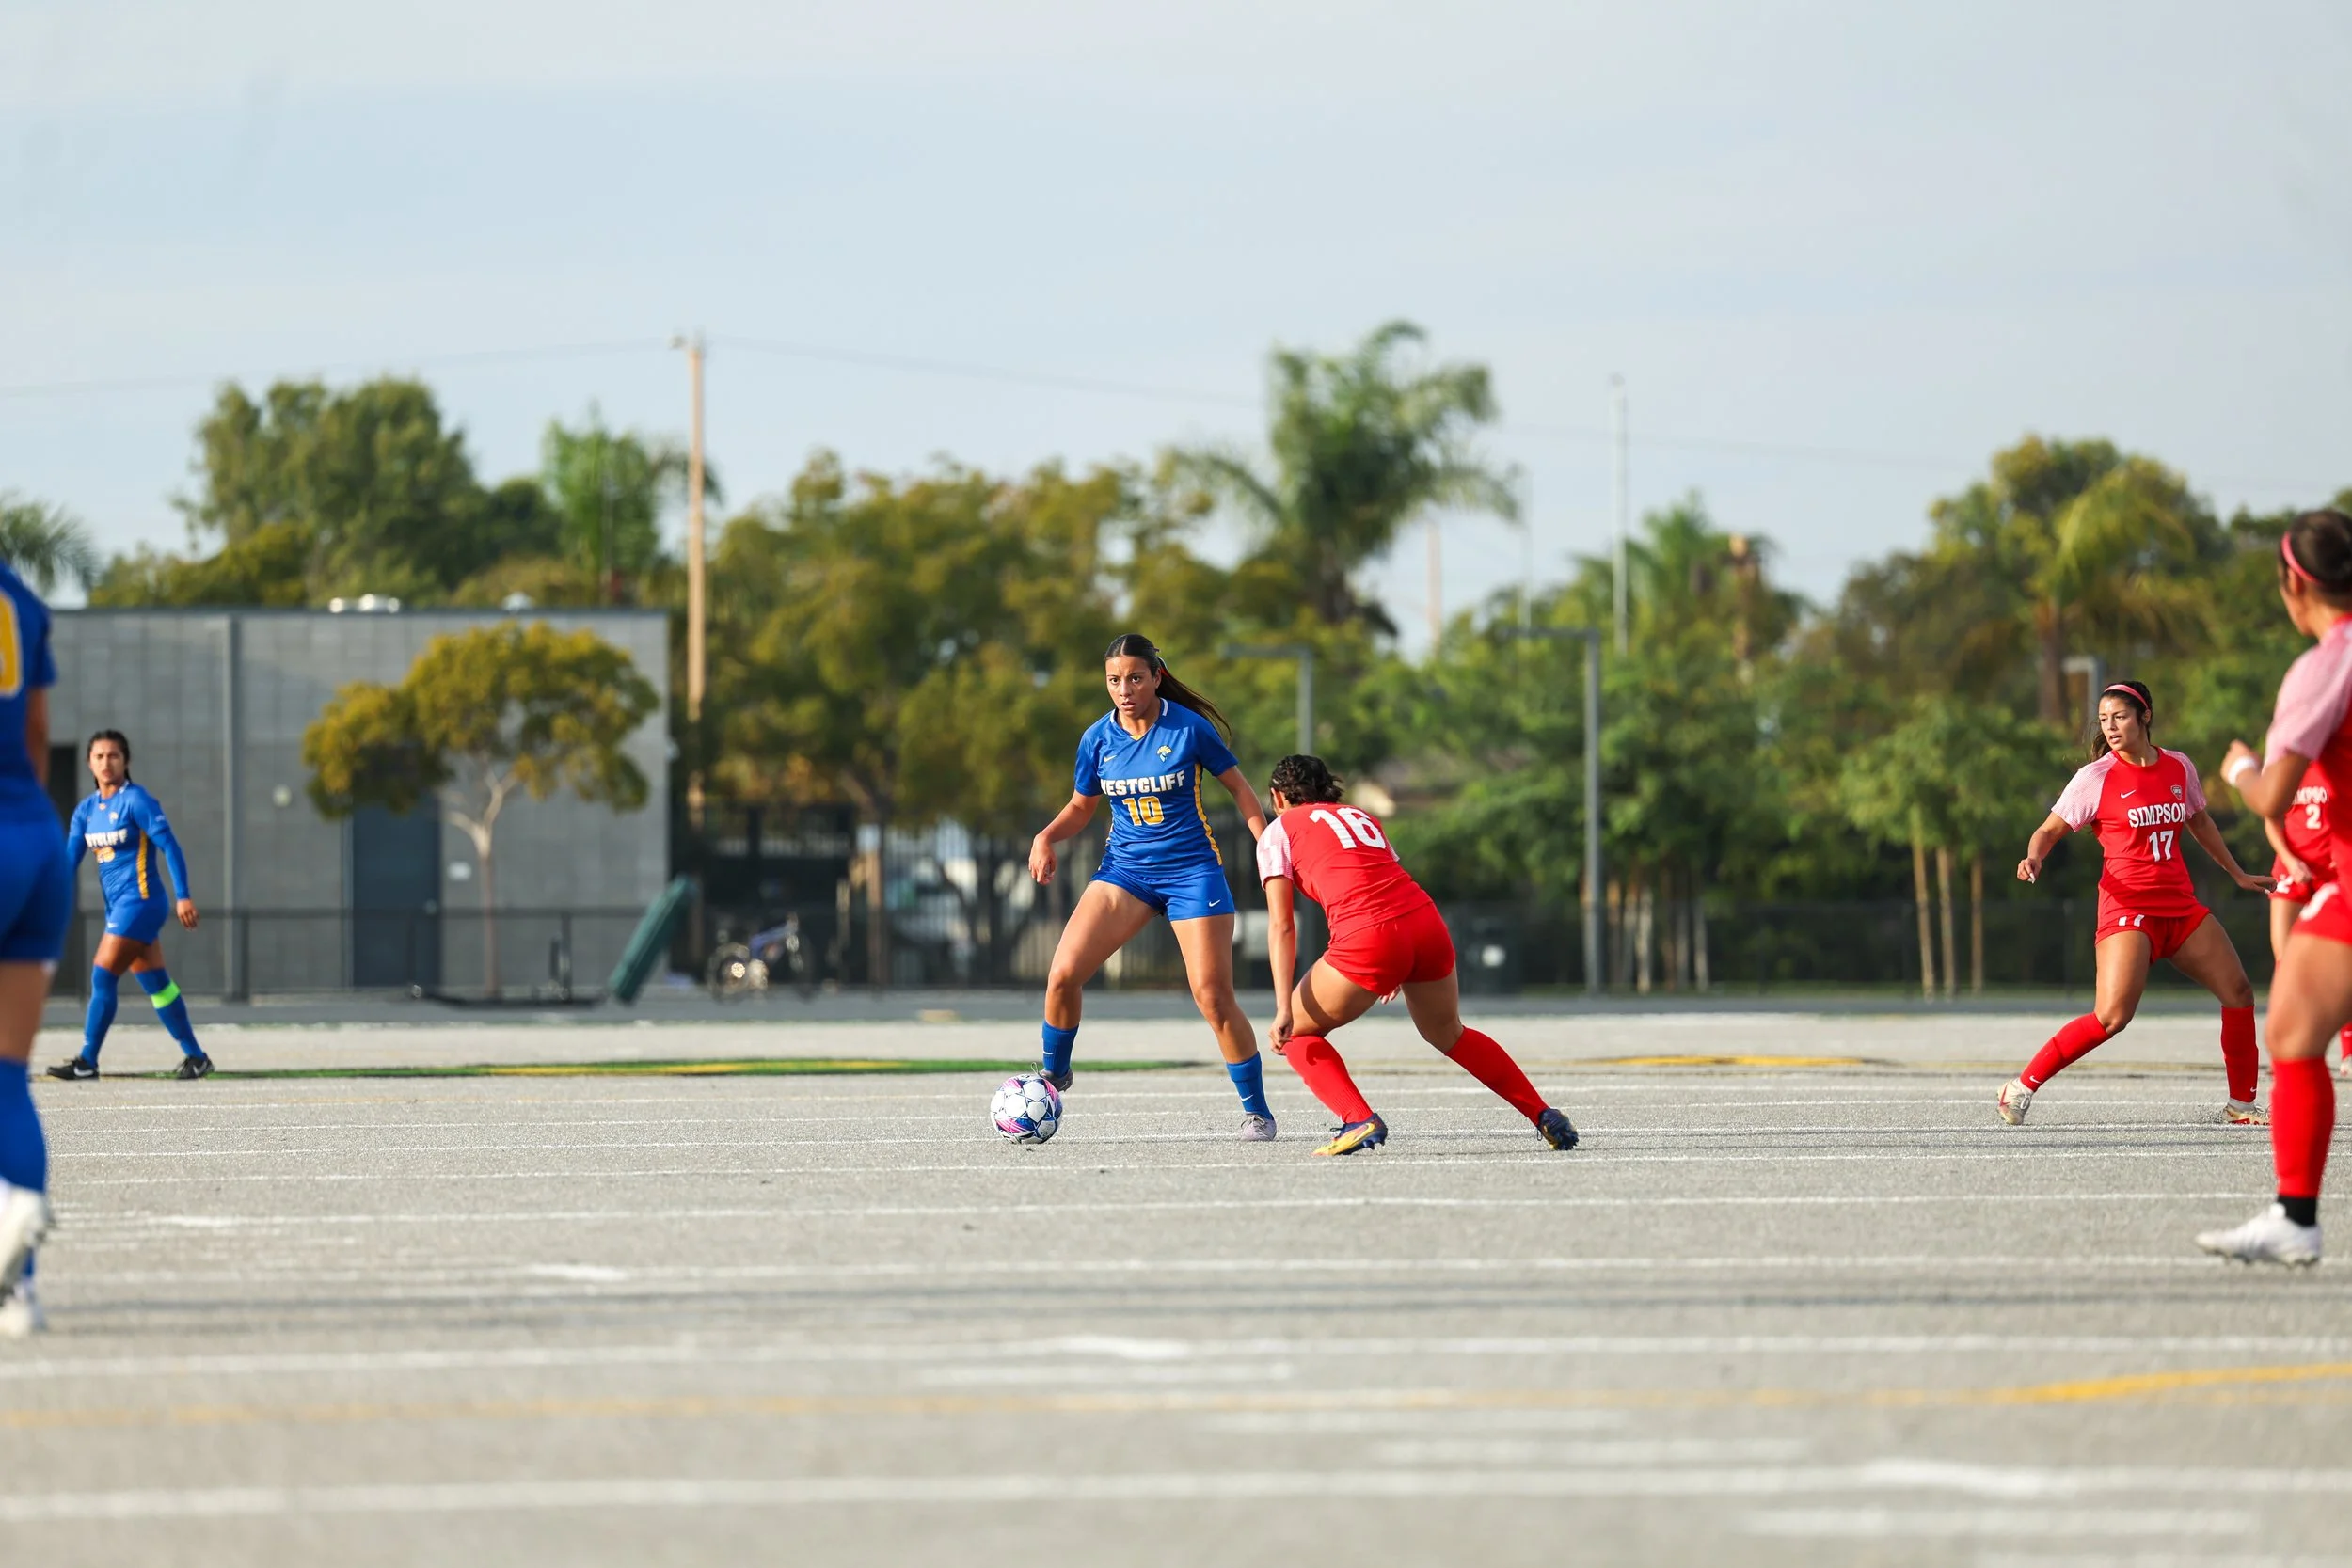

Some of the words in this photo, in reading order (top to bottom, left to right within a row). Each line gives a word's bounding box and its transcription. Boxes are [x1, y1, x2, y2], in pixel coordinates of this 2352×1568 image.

[1121, 796, 1165, 826] 10
[2127, 802, 2186, 828] SIMPSON
[2305, 804, 2322, 829] 2
[1309, 807, 1387, 849] 16
[2149, 830, 2174, 862] 17
